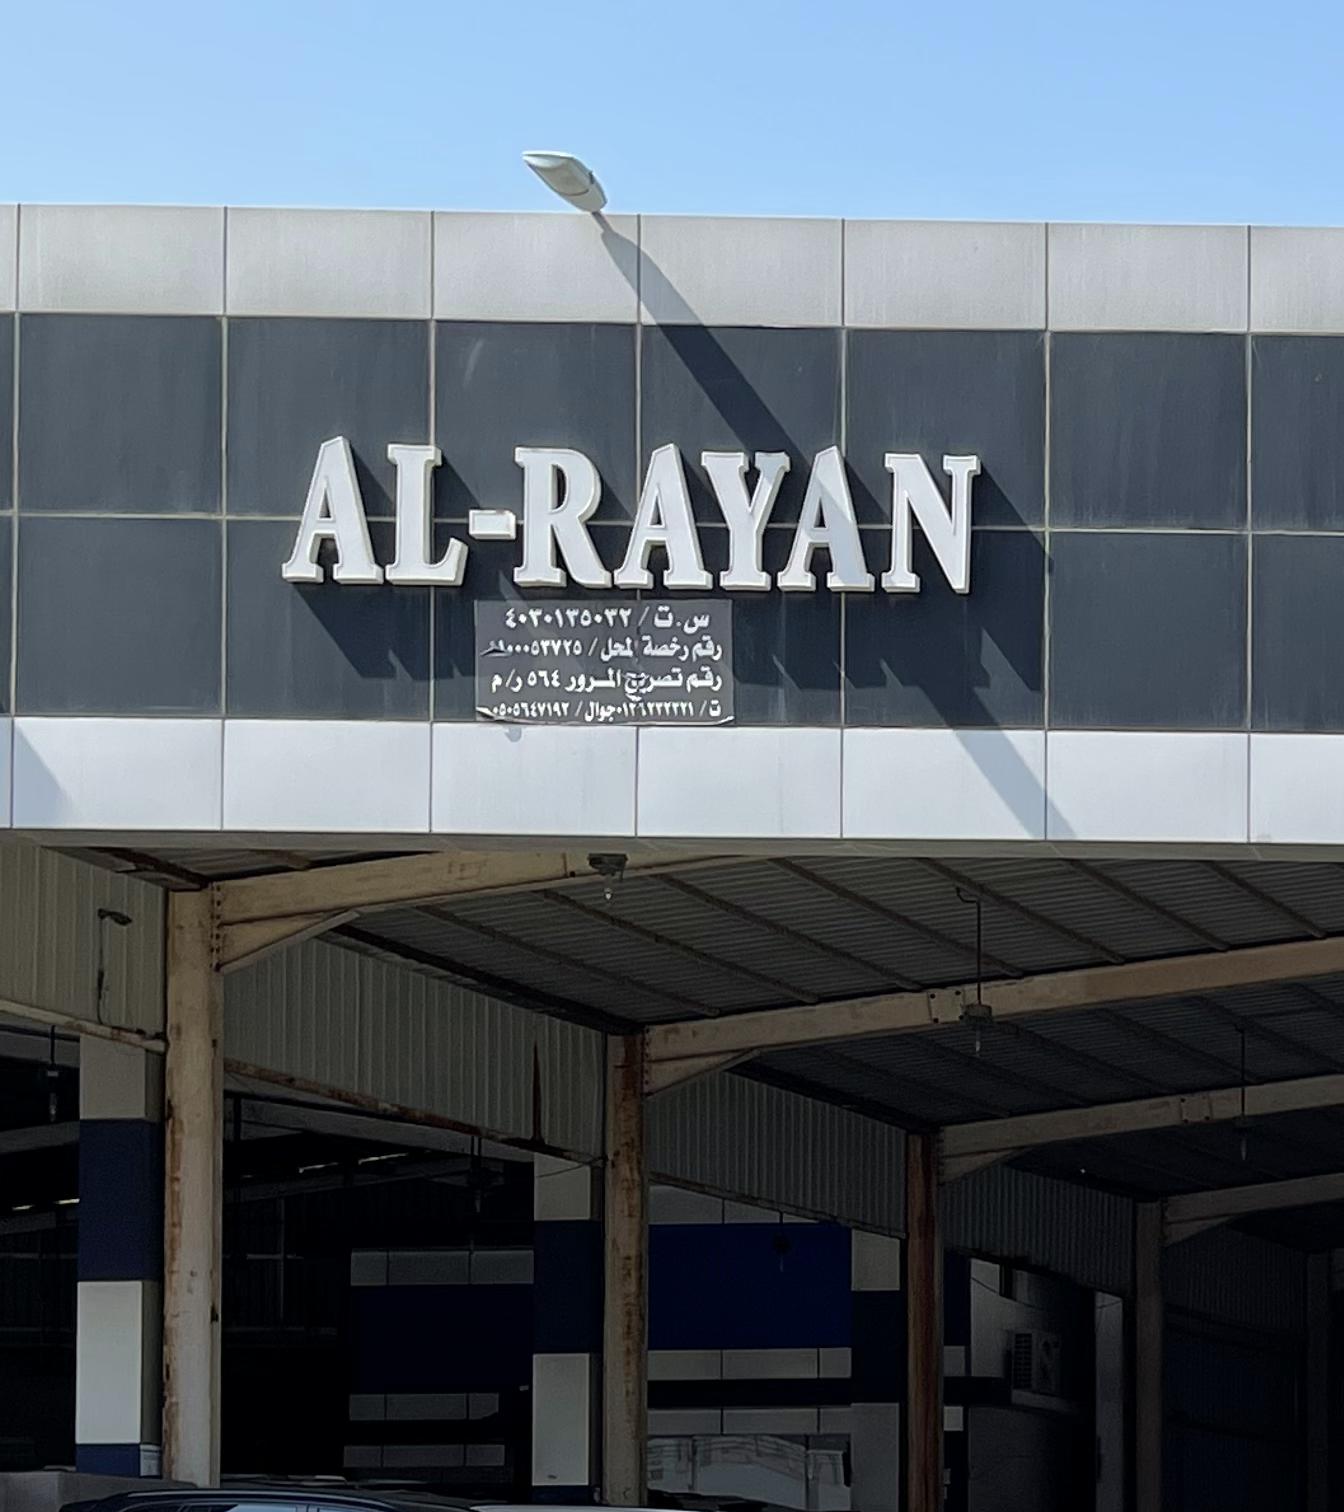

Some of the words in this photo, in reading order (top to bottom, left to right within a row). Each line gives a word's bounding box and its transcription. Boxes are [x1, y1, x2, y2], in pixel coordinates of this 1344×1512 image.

[281, 435, 982, 594] AL-RAYAN
[641, 634, 690, 661] رخصة
[692, 634, 723, 662] رقم
[527, 669, 561, 688] ٥٦٤
[564, 667, 622, 693] المرور
[686, 665, 723, 693] رقم
